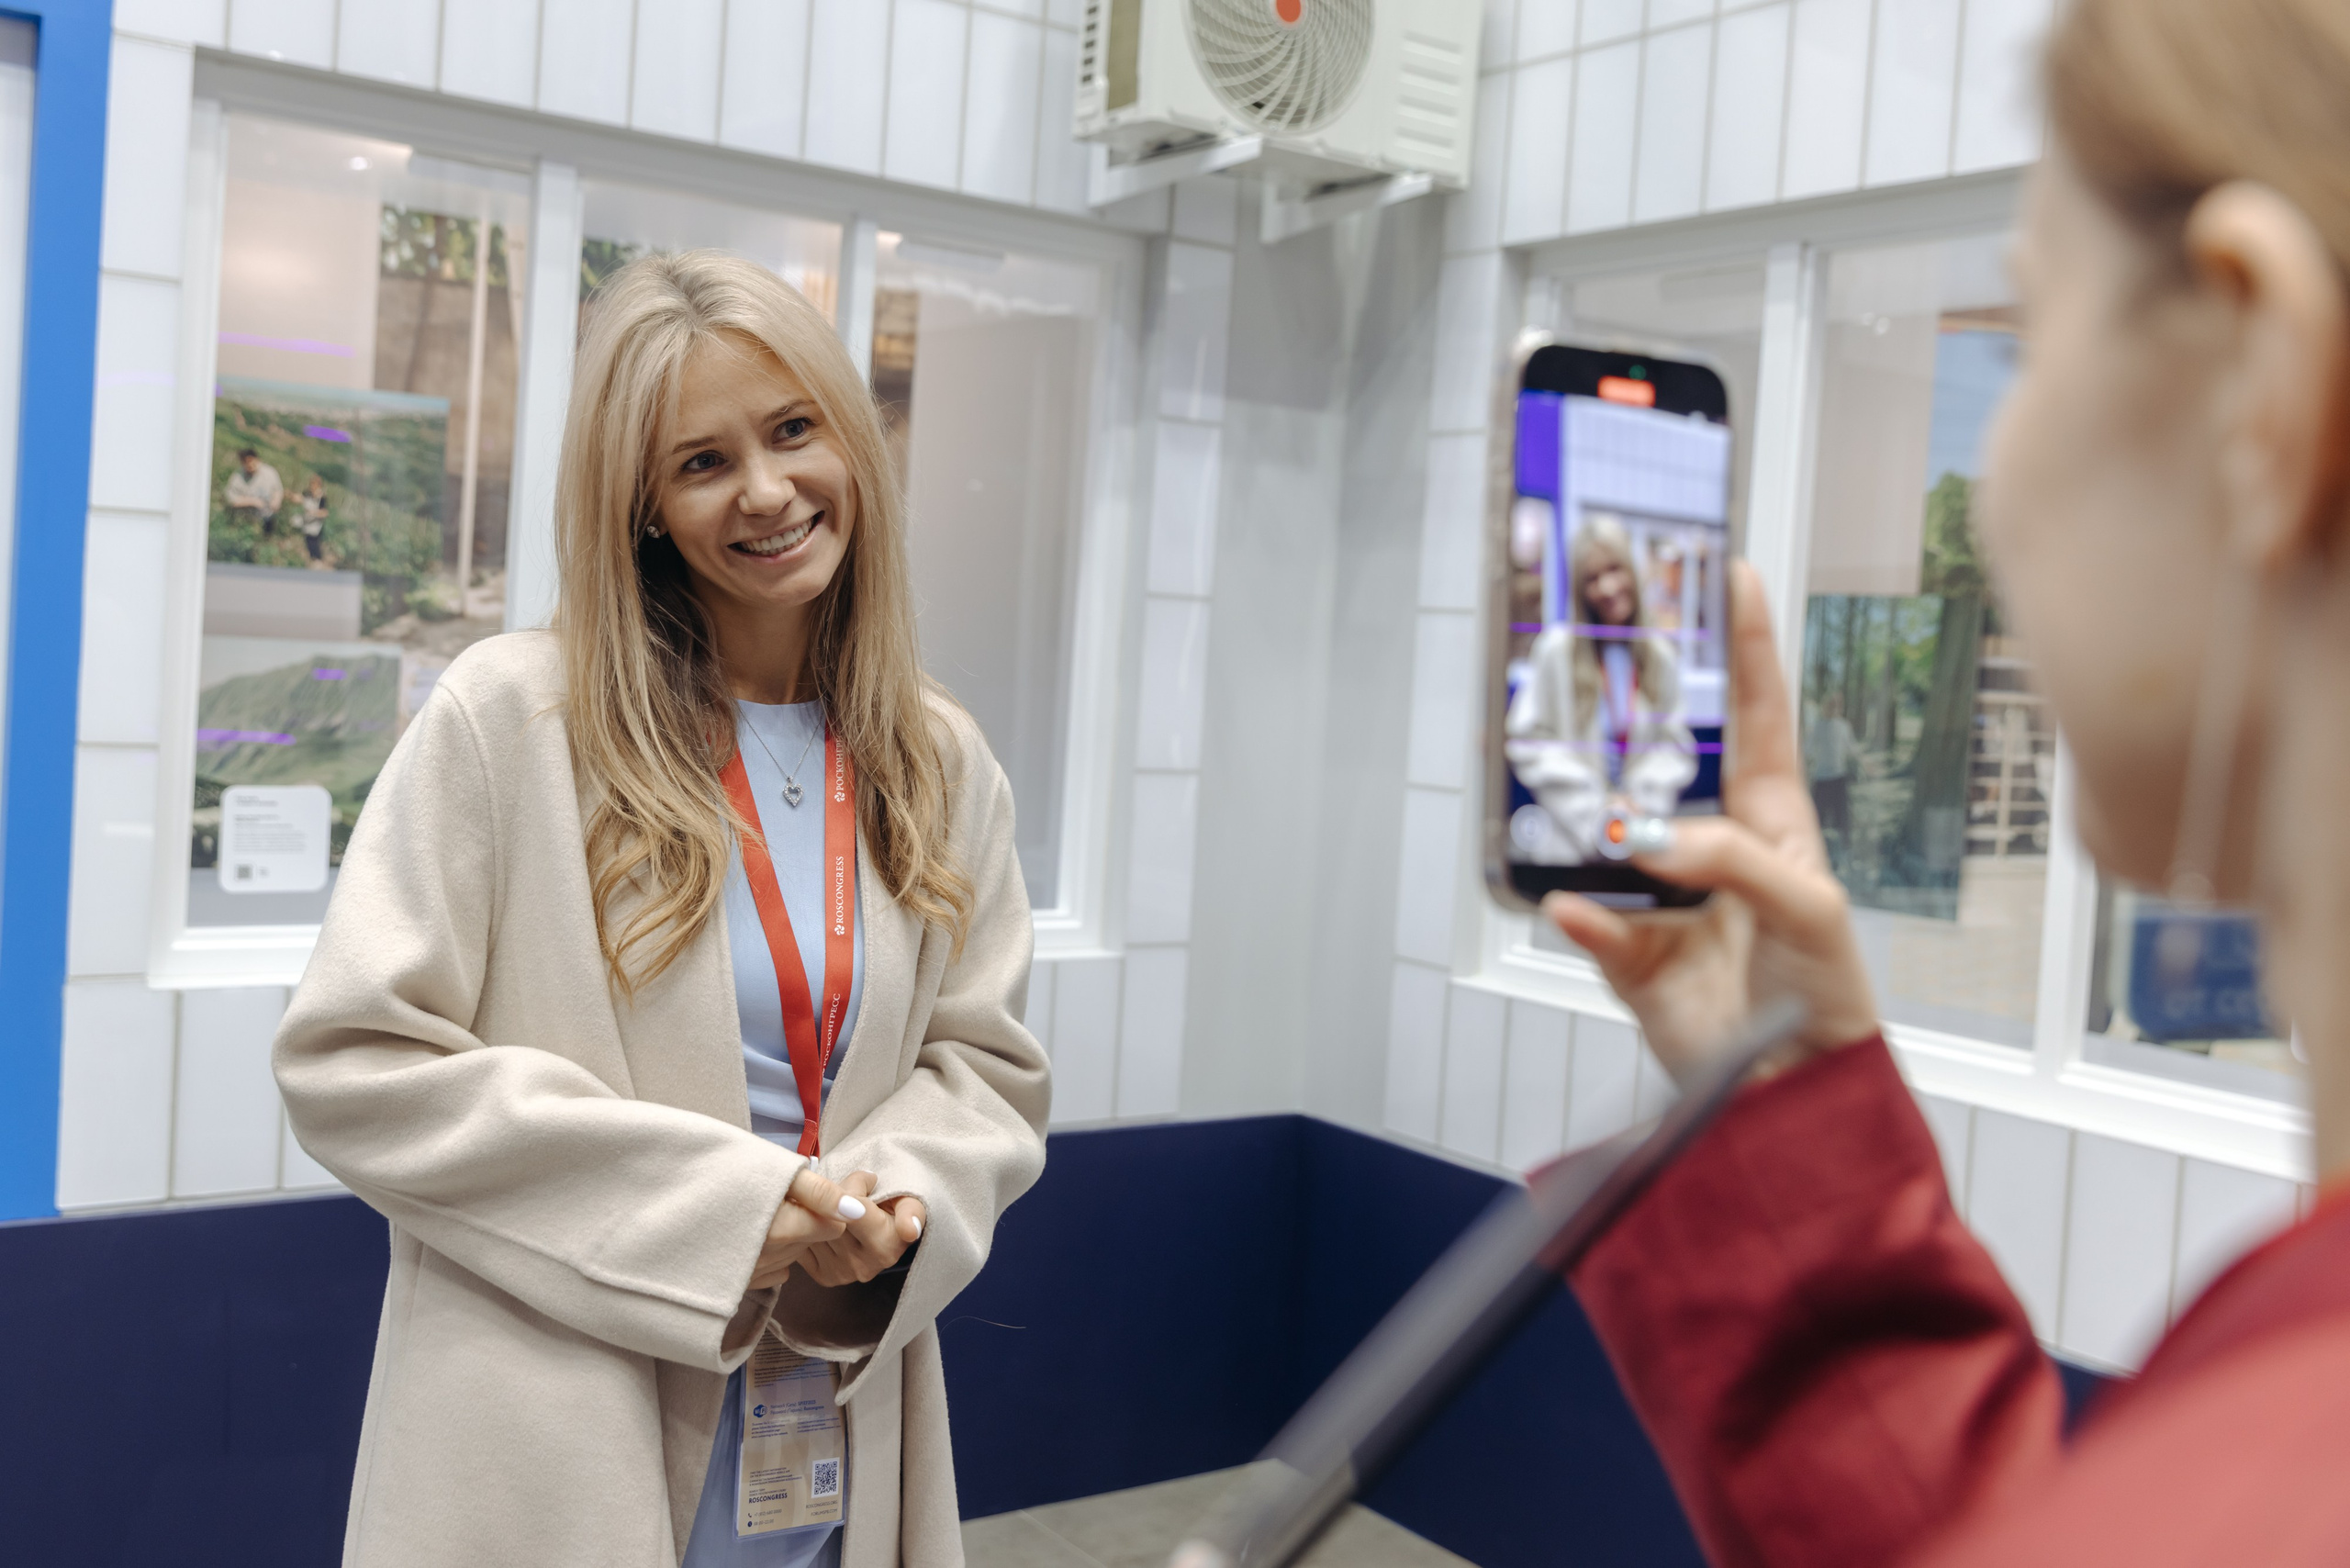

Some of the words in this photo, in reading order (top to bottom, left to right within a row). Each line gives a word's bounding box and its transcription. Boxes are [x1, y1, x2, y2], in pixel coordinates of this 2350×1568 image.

[835, 732, 845, 791] РОСКОНГРЕ
[835, 856, 845, 924] ROSCONGRESS
[822, 992, 841, 1067] РОСКОНГРЕСС
[749, 1493, 788, 1504] ROSCONGRESS
[806, 1500, 837, 1508] ROSCONGRESS.ORG
